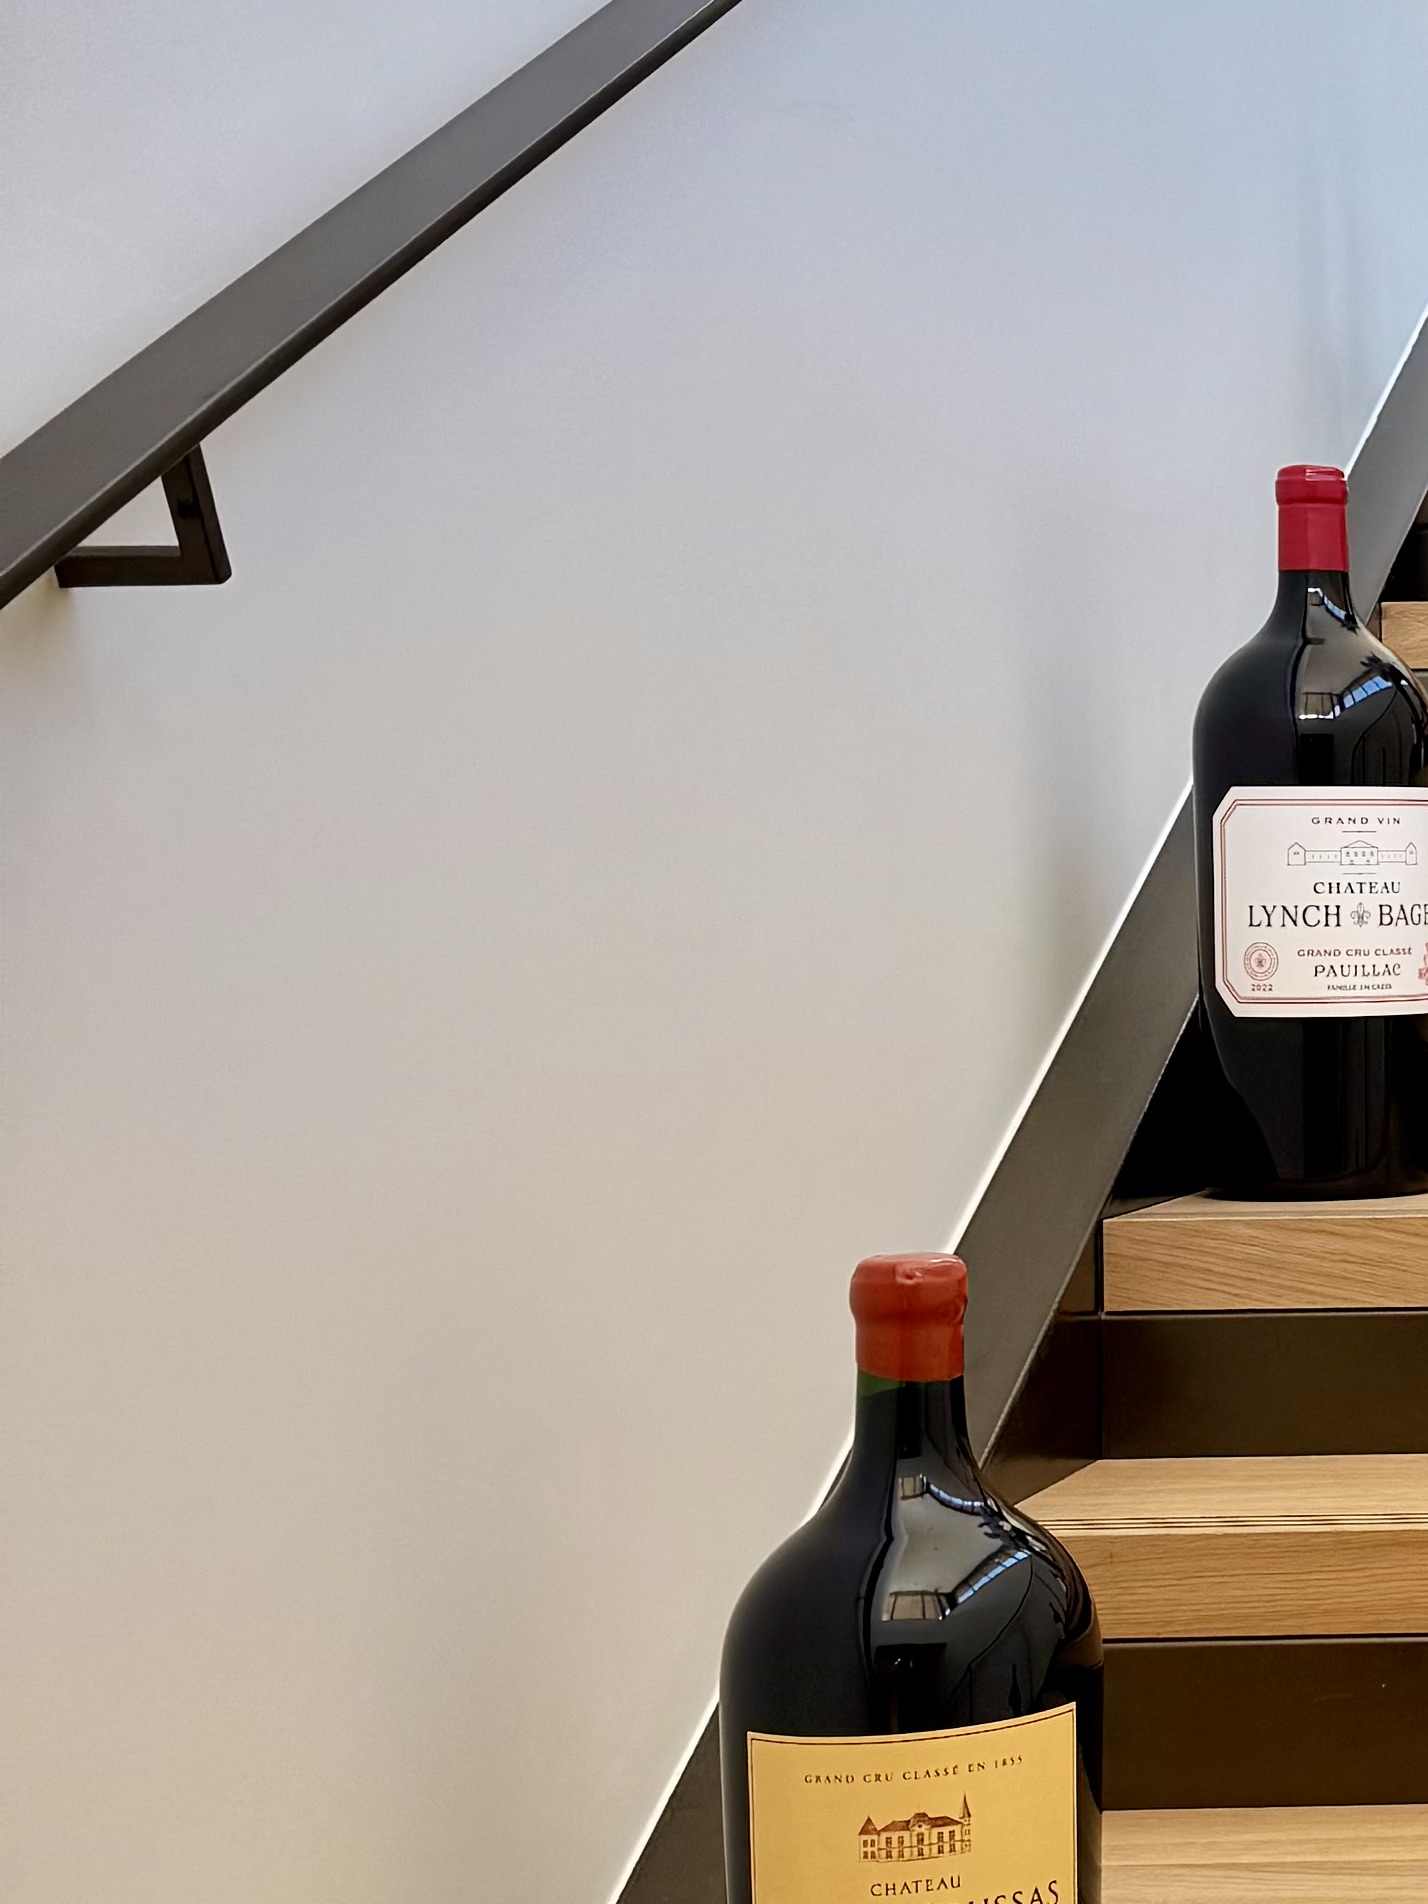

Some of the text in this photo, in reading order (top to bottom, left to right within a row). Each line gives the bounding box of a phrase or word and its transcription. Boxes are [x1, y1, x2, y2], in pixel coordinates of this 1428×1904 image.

[1311, 817, 1401, 825] GRAND VIN
[1313, 881, 1401, 895] CHATEAU
[1248, 905, 1341, 928] LYNCH
[1297, 949, 1341, 957] GRAND
[1314, 963, 1401, 977] PAUILLAC
[804, 1754, 1023, 1784] GRAND CRU CLASSÉ EN 1855
[870, 1875, 961, 1897] CHATEAU
